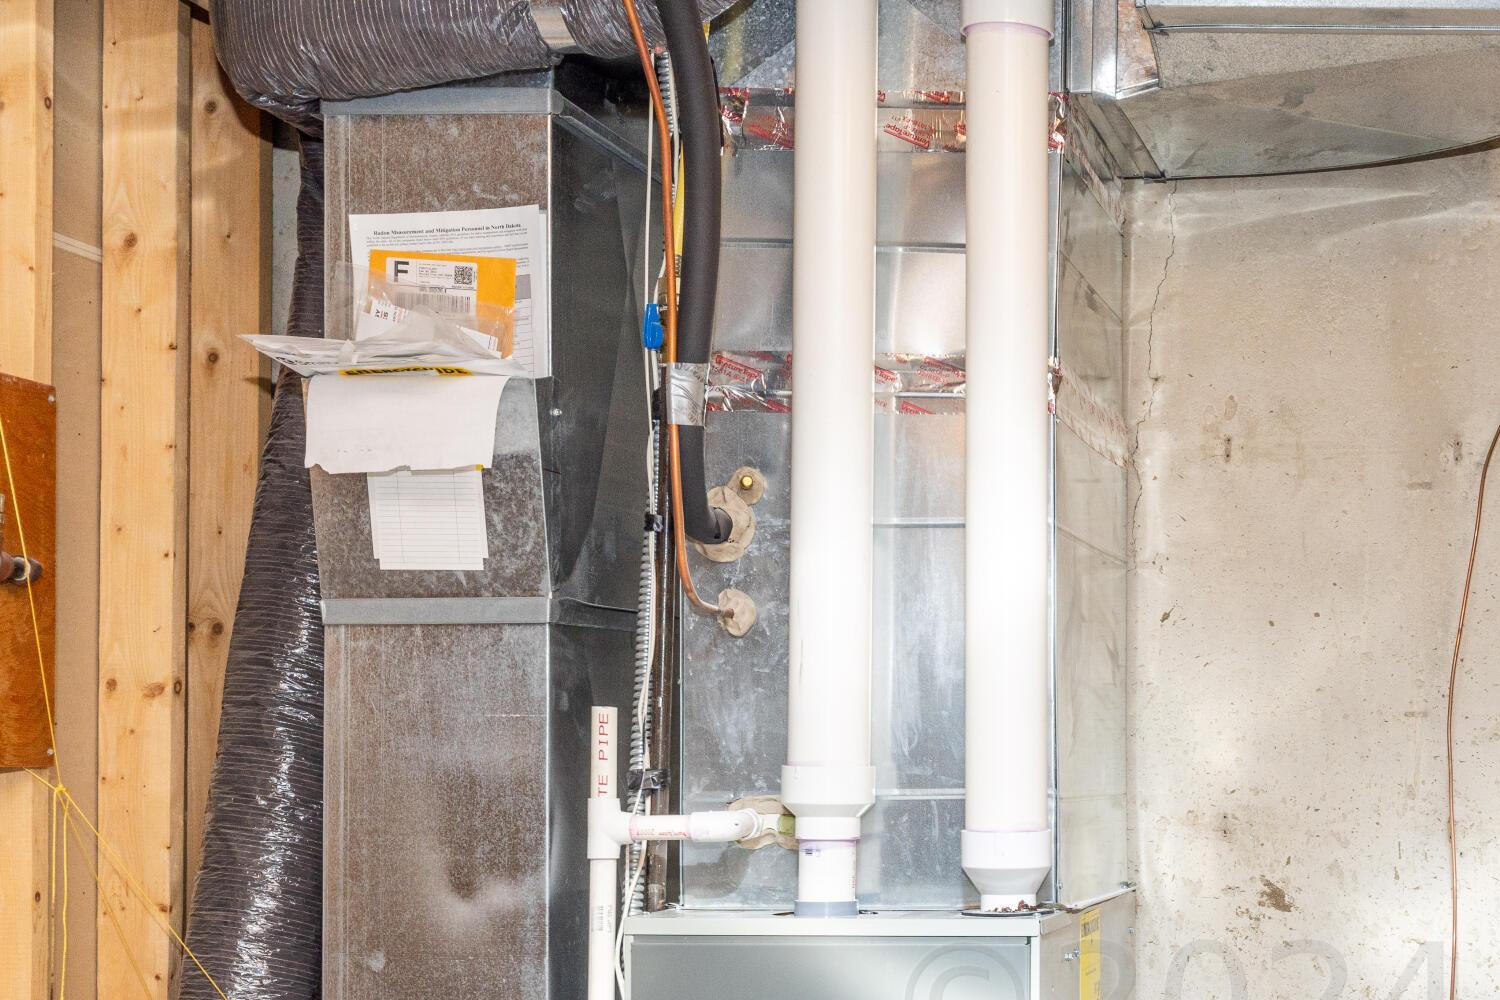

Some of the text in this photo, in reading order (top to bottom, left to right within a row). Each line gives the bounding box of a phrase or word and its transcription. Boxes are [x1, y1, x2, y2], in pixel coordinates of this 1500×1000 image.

[436, 226, 461, 234] Mitigation
[394, 260, 409, 282] F
[599, 712, 609, 761] PIPE
